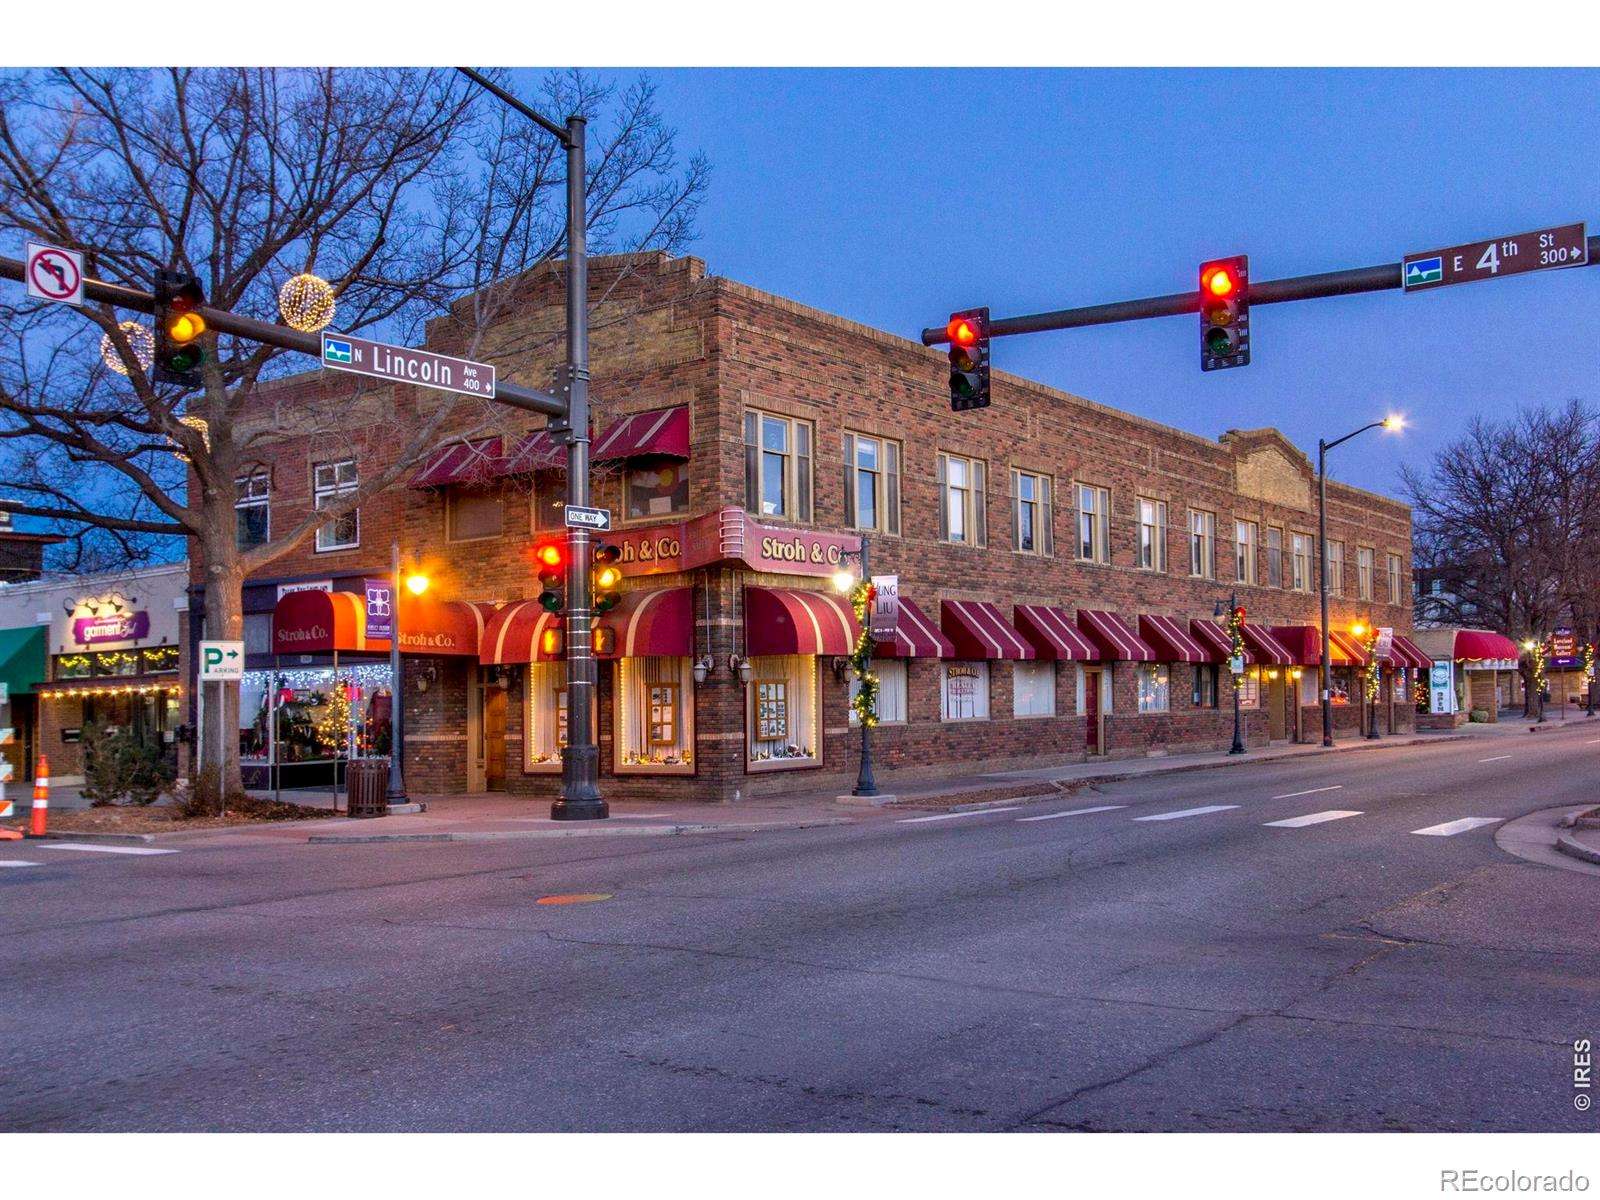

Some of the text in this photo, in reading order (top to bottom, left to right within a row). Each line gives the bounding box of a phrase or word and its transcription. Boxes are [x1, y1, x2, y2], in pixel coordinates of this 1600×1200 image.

[1453, 233, 1554, 274] E 4th St
[1540, 247, 1567, 265] 300
[354, 346, 477, 385] N Lincoln Ave
[463, 378, 480, 391] 400
[570, 511, 597, 523] ONE WAY
[640, 540, 653, 560] &
[658, 537, 682, 557] Co.
[762, 536, 806, 563] Stroh
[811, 541, 824, 563] &
[877, 600, 894, 615] LIU
